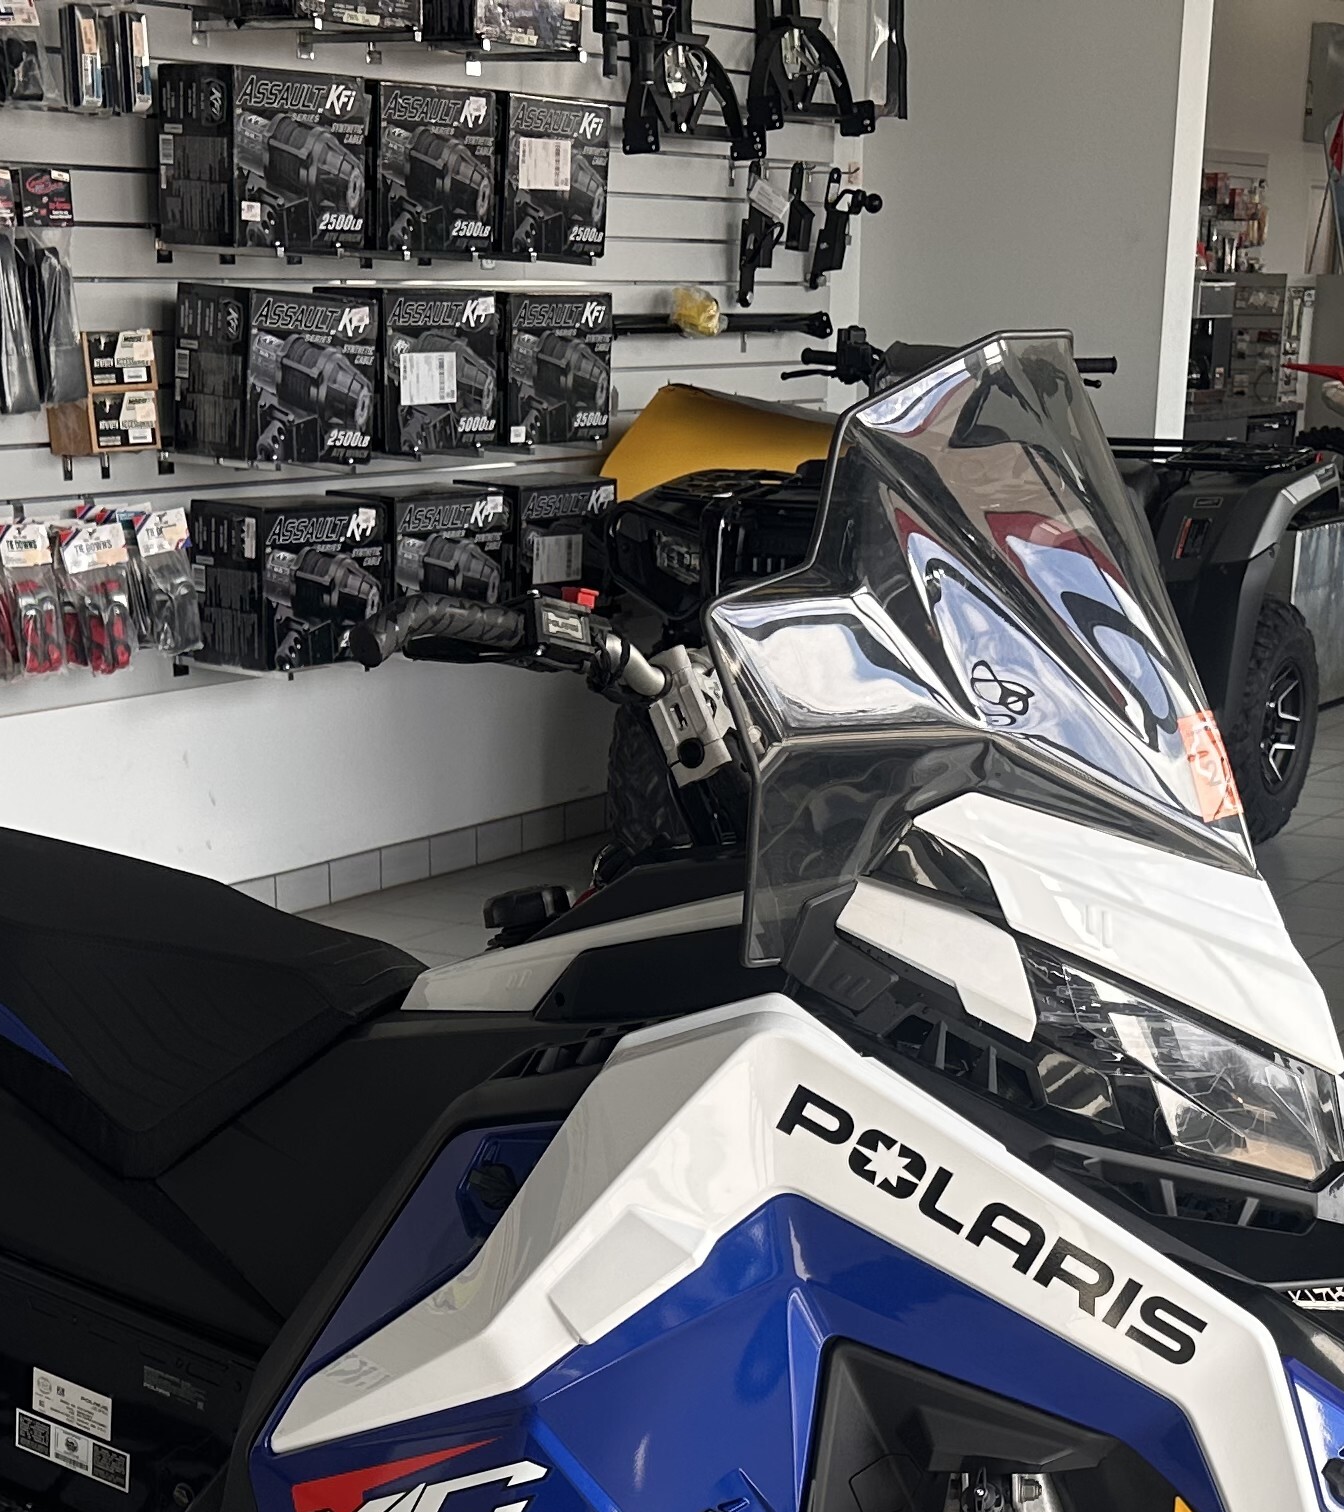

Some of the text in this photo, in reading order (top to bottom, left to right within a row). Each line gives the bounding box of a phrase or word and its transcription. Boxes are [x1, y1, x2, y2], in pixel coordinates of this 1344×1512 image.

[236, 75, 327, 110] ASSAULT
[383, 90, 461, 124] ASSAULT
[512, 102, 582, 135] ASSAULT
[251, 298, 340, 333] ASSAULT
[387, 297, 464, 326] ASSAULT
[514, 300, 582, 328] ASSAULT
[398, 504, 472, 533] ASSAULT
[522, 492, 590, 520] ASSAULT
[266, 515, 349, 545] ASSAULT
[775, 1084, 1208, 1365] POLARIS
